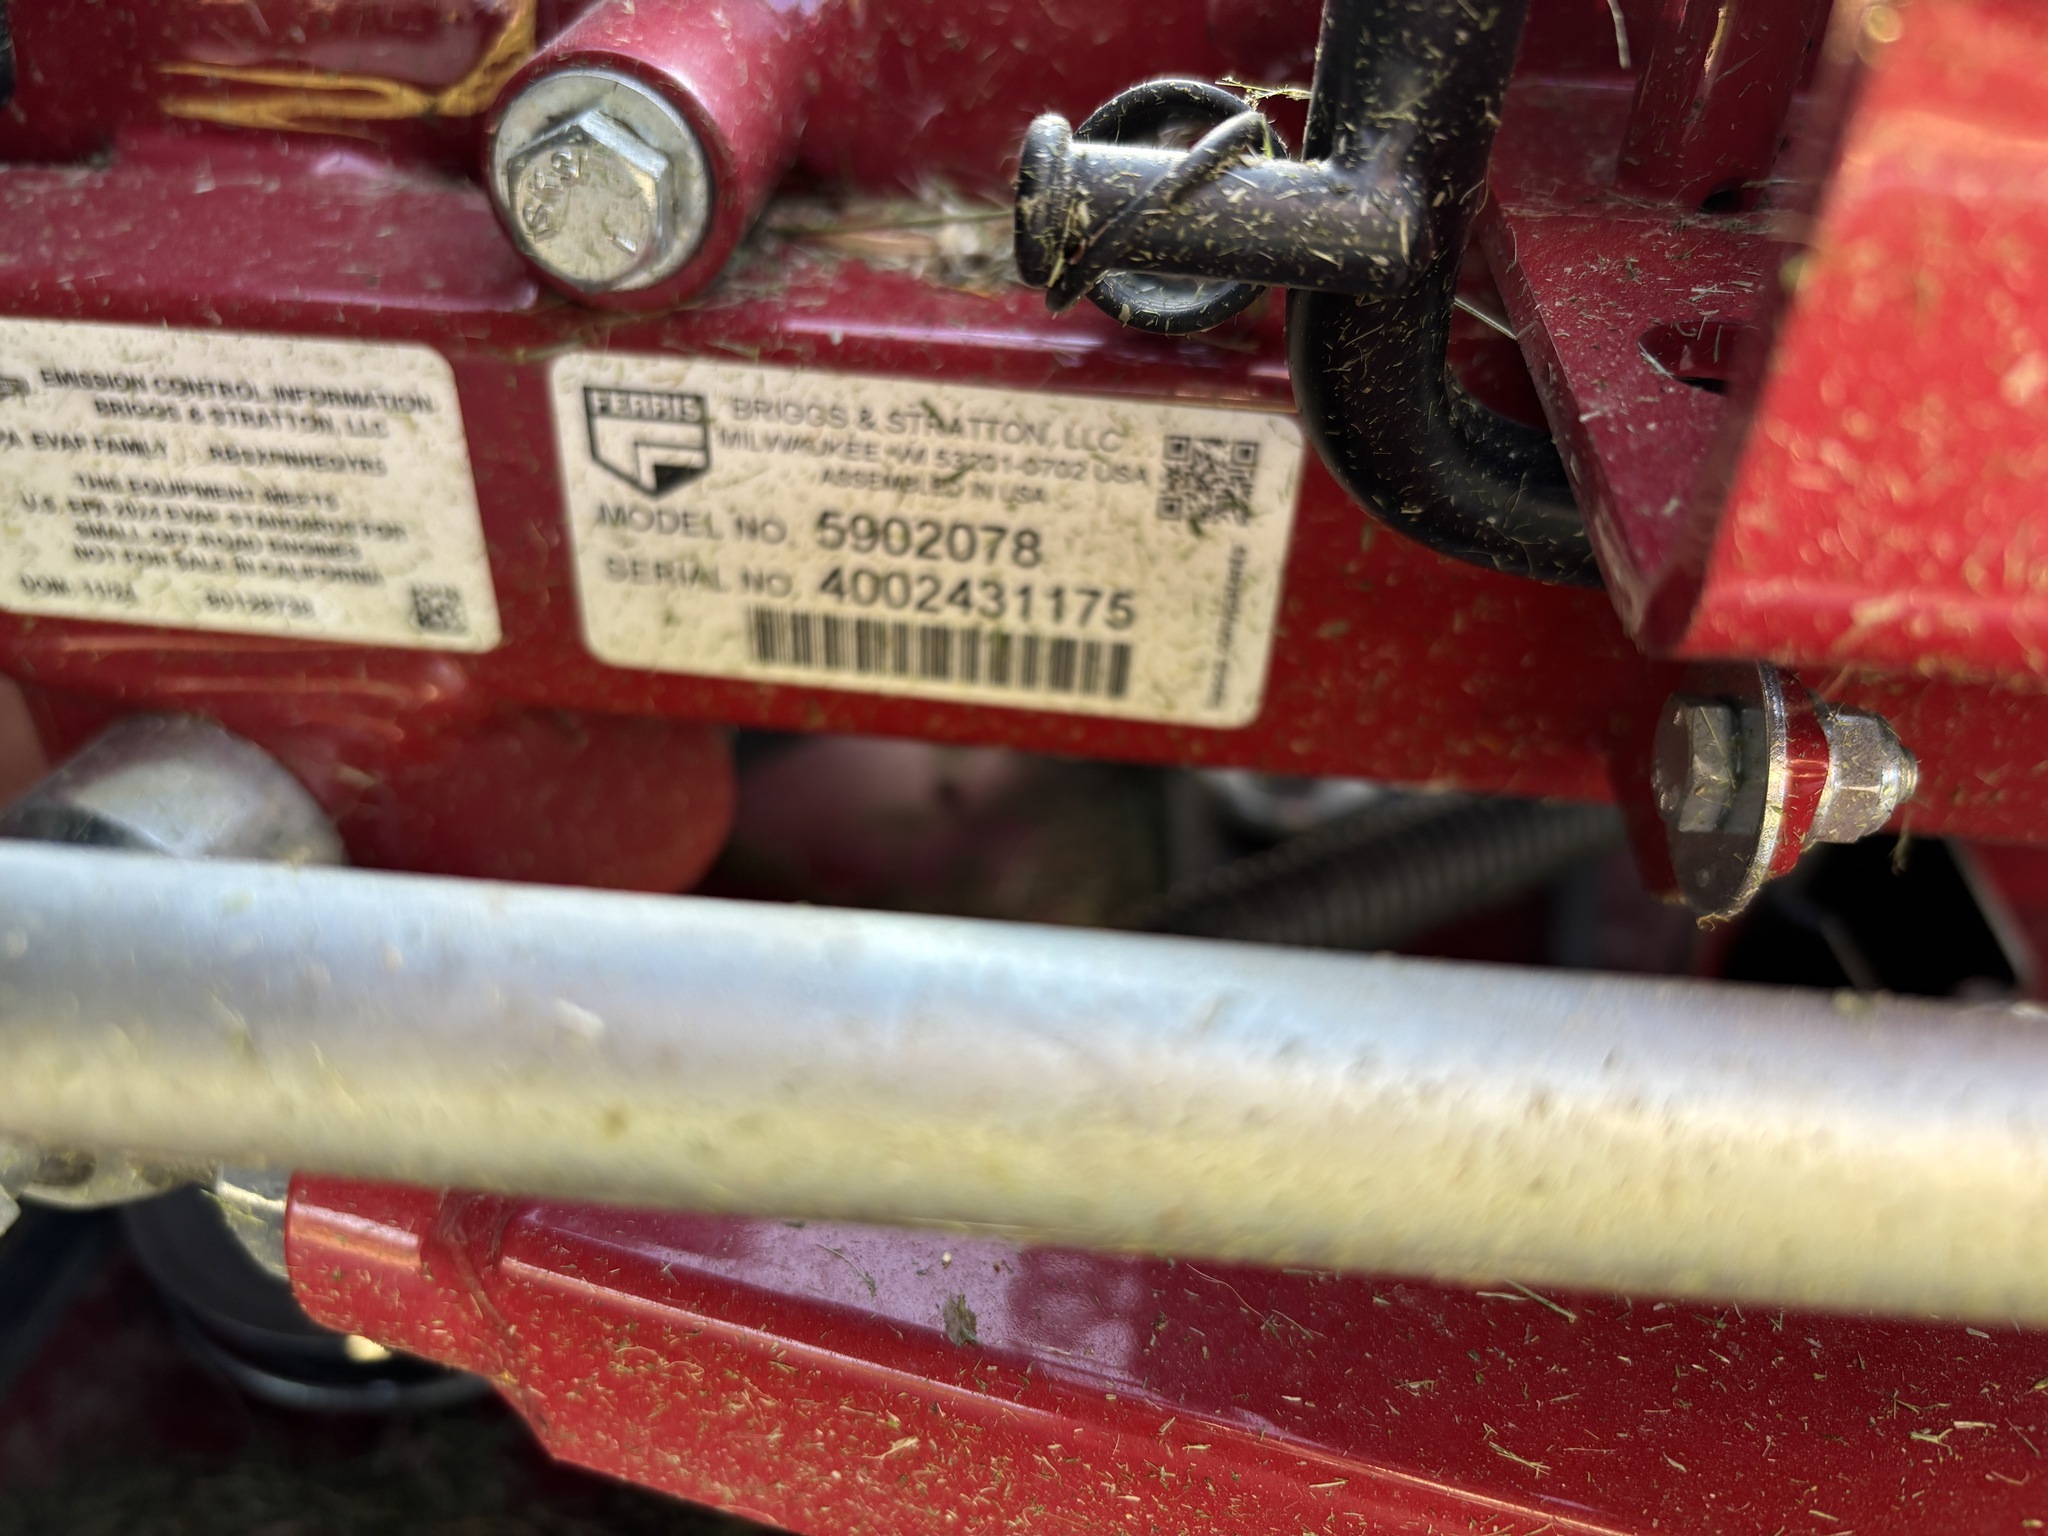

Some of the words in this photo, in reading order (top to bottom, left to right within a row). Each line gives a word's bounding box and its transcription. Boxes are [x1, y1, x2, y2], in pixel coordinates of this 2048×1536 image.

[41, 367, 147, 393] EMISSION
[272, 383, 435, 412] INFORMATION
[733, 397, 850, 429] BRIGGS
[855, 407, 876, 430] &
[1063, 421, 1125, 451] LLC
[1093, 460, 1150, 484] USA
[598, 501, 722, 541] MODEL
[816, 510, 1043, 568] 5902078
[606, 557, 728, 591] SERIAL
[819, 568, 1136, 629] 4002431175
